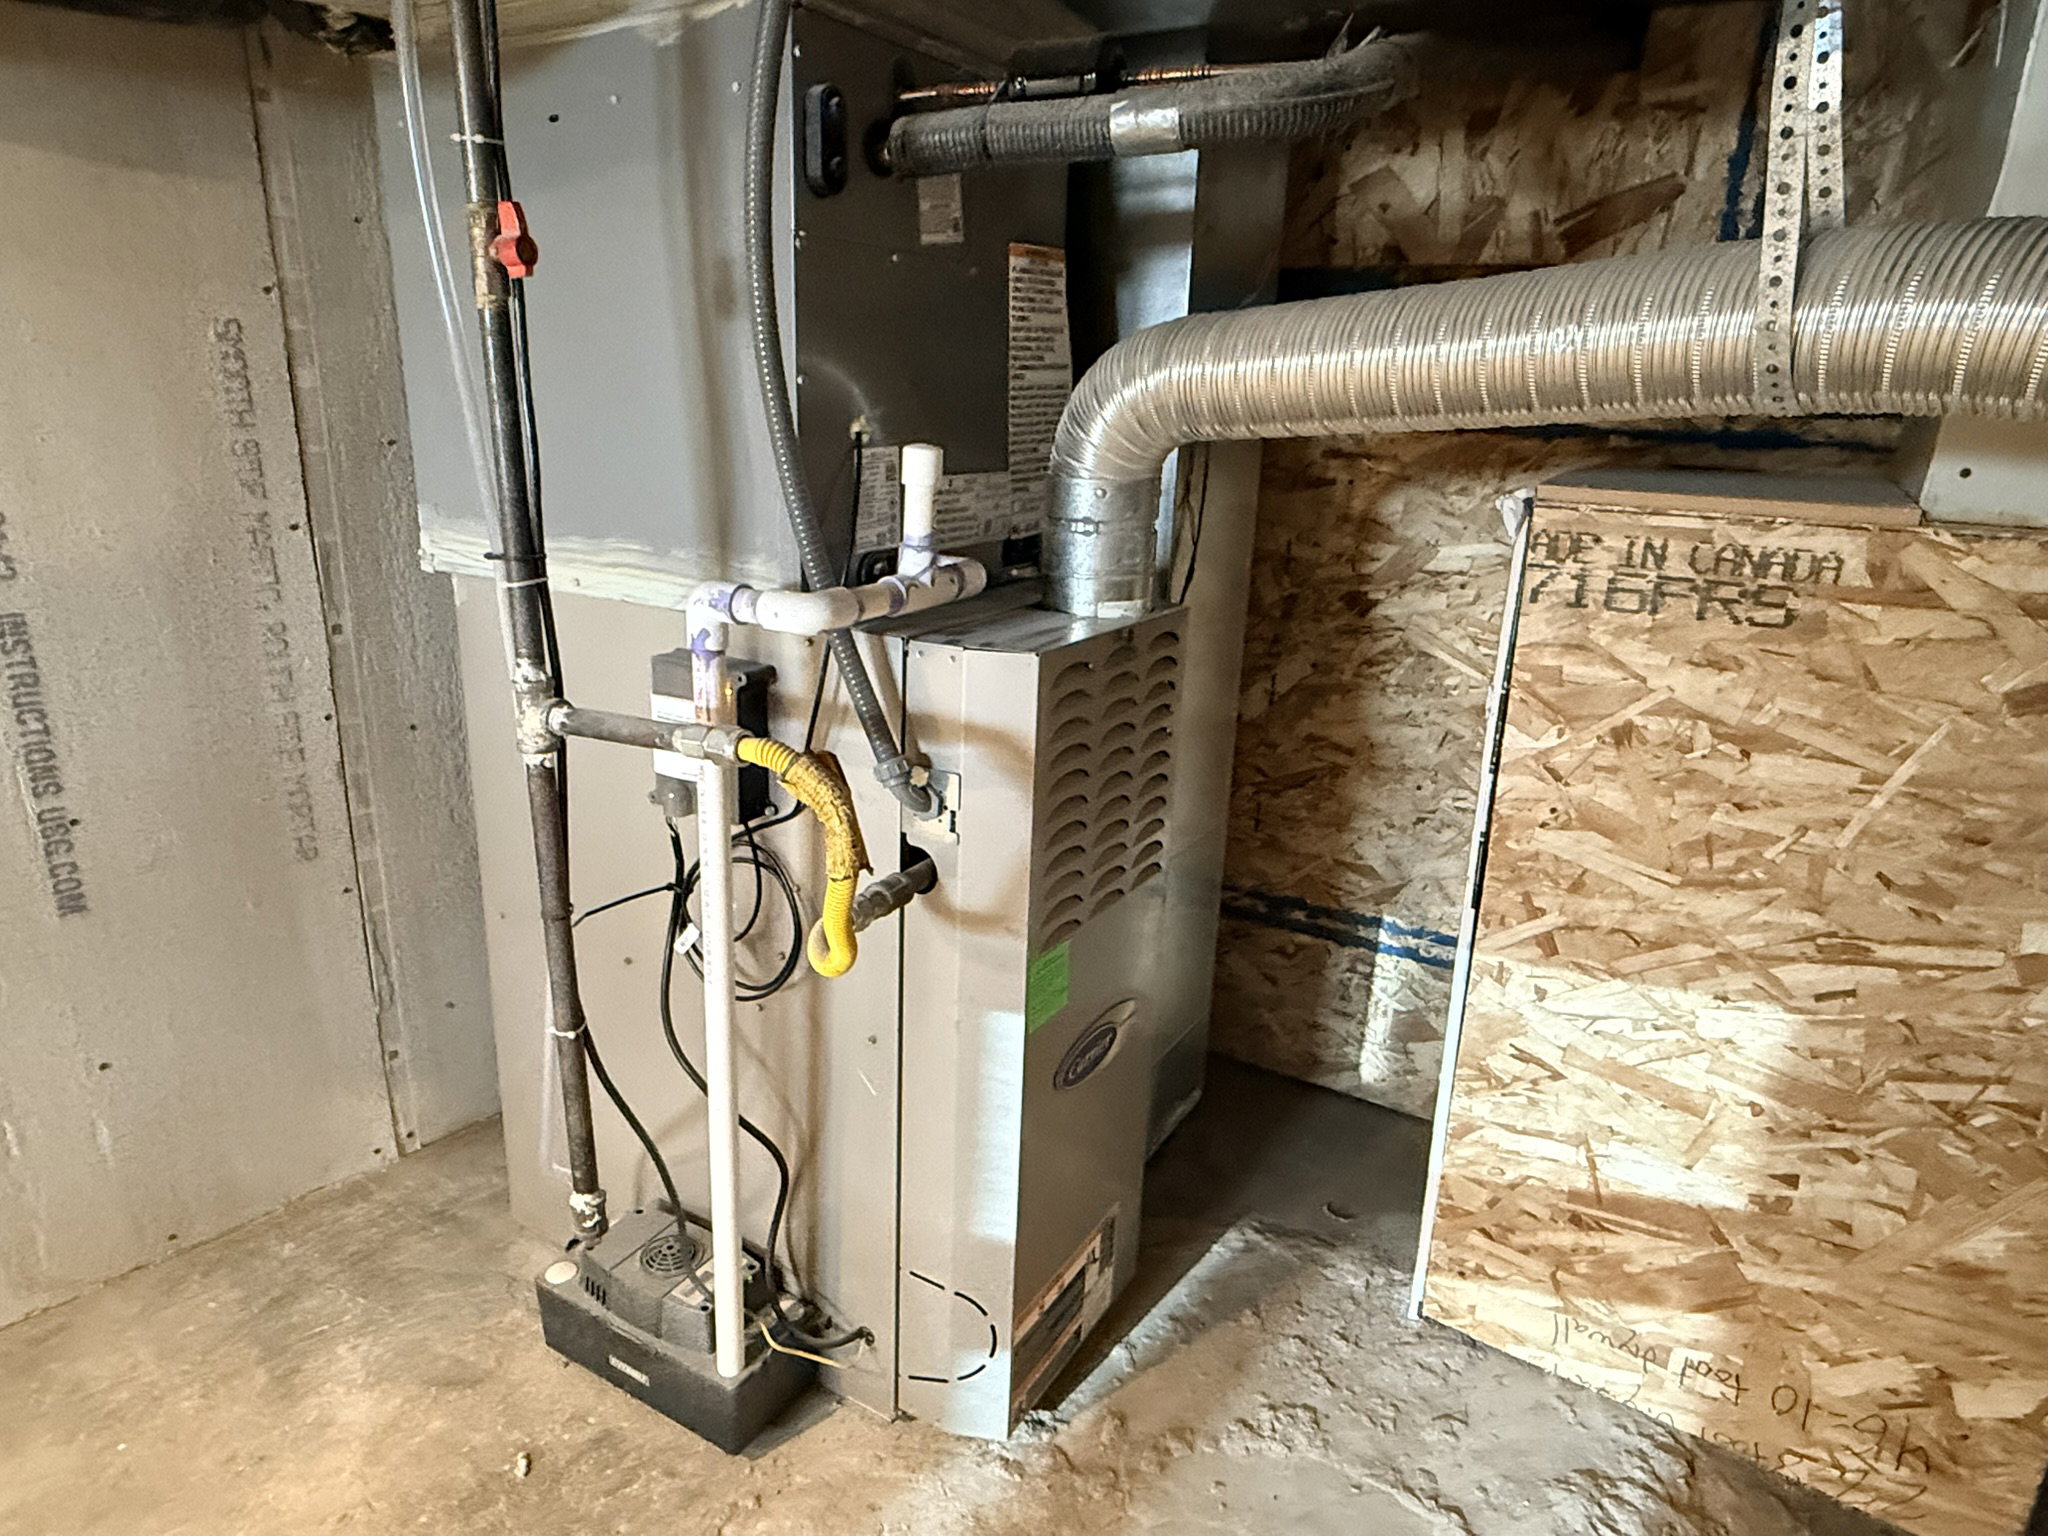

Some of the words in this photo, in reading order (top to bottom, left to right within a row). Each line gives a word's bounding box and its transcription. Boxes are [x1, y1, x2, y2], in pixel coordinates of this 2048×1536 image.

[1617, 535, 1669, 569] IN
[1688, 540, 1846, 584] CANADA
[1551, 1314, 1657, 1374] drywall
